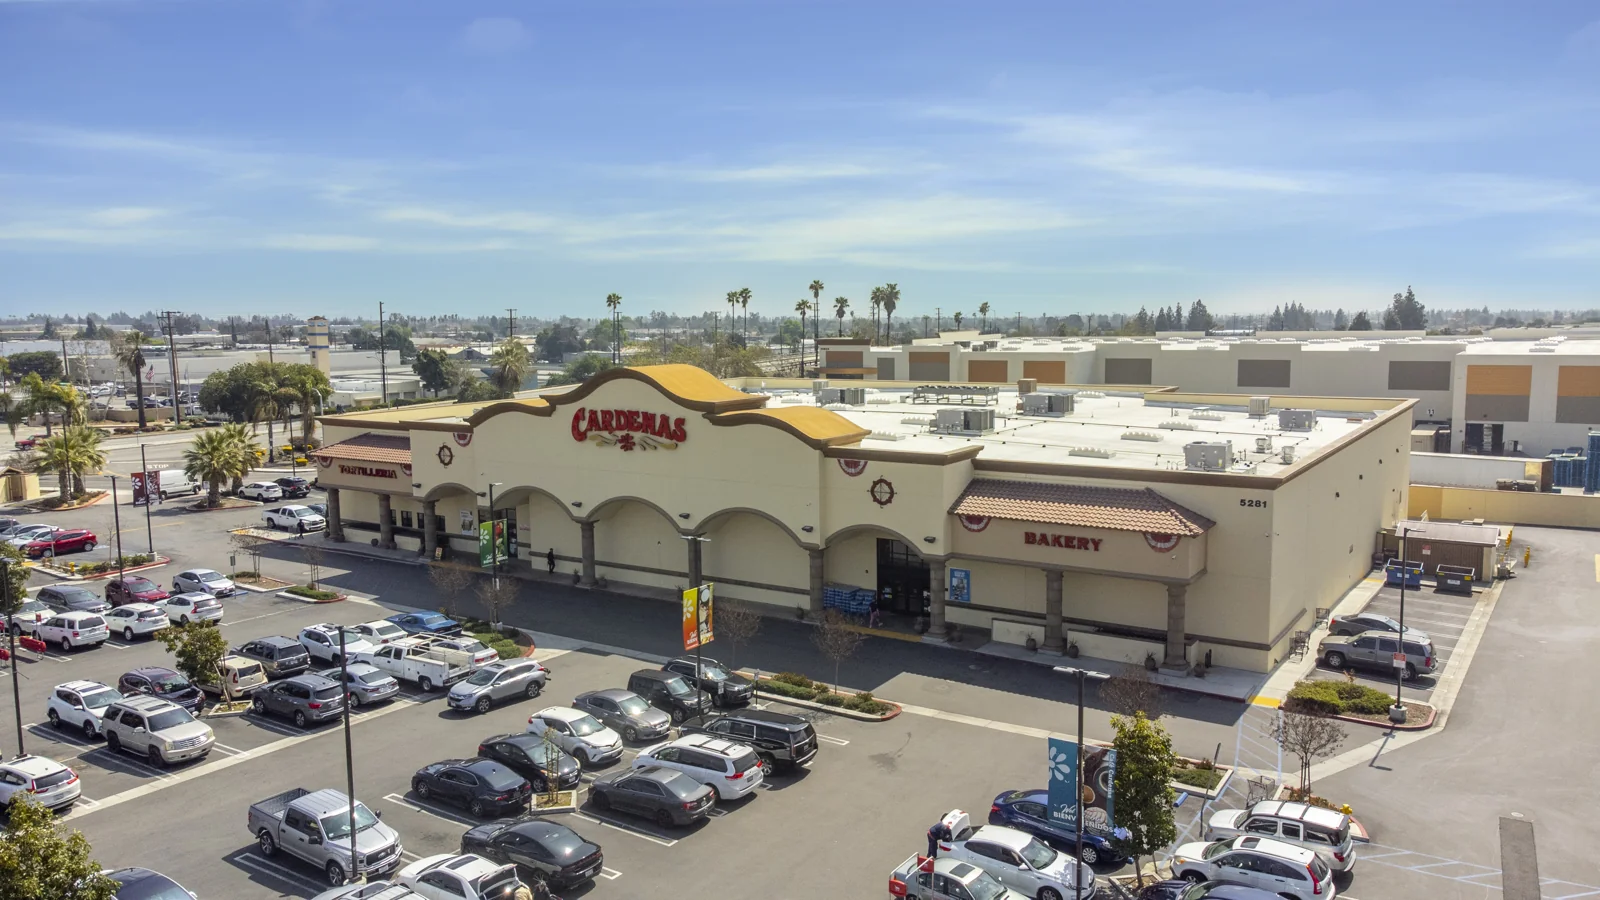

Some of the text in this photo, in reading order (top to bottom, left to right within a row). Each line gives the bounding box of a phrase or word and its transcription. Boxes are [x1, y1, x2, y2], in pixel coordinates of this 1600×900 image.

[571, 407, 687, 442] CARDENAS
[338, 464, 398, 479] TORTILLERIA
[1239, 498, 1267, 508] 5281
[1024, 531, 1103, 552] BAKERY
